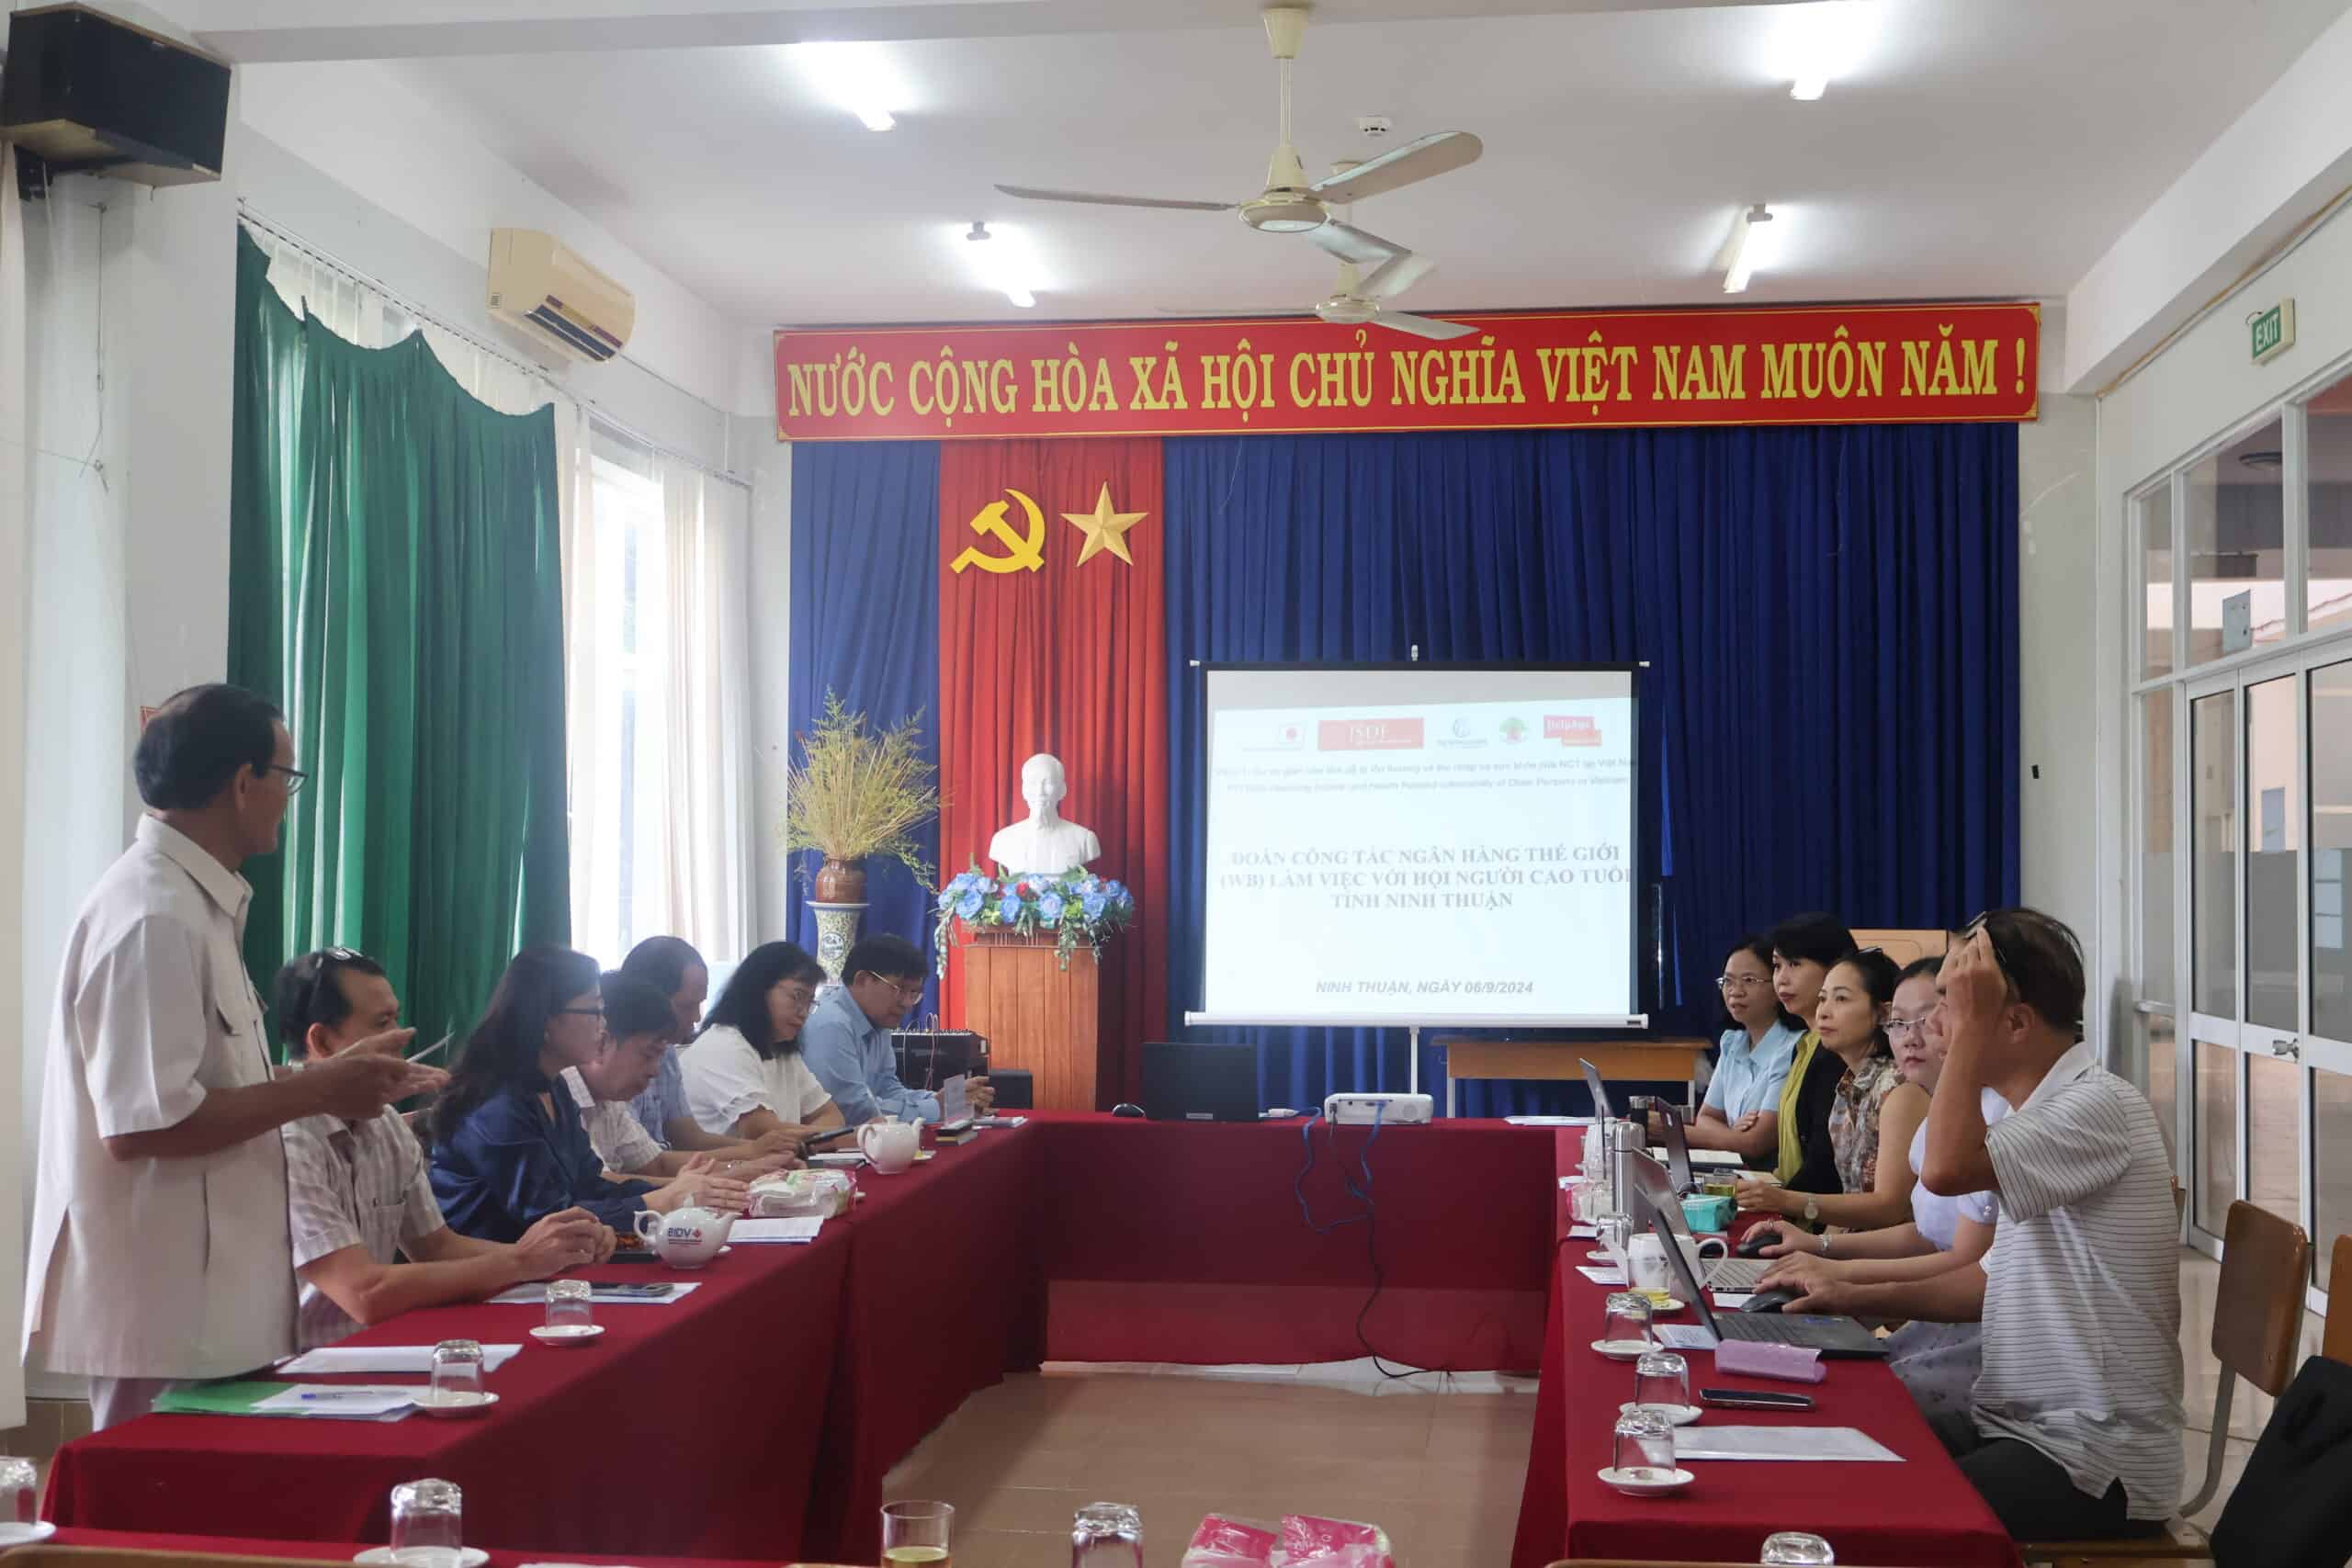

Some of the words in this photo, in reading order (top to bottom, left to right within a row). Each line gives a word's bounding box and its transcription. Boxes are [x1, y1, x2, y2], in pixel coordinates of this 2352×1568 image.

[2256, 313, 2278, 352] EXIT
[787, 345, 895, 416] NƯỚC
[909, 344, 1018, 427] CỘNG
[1031, 342, 1119, 412] HÒA
[1129, 340, 1188, 411] XÃ
[1201, 338, 1275, 423] HỘI
[1289, 329, 1374, 407] CHỦ
[1390, 334, 1526, 405] NGHĨA
[1536, 330, 1638, 415] VIỆT
[1653, 344, 1746, 400] NAM
[1760, 324, 1886, 398] MUÔN
[1900, 323, 1999, 396] NĂM
[1291, 846, 1349, 865] CÔNG
[1397, 844, 1455, 864] NGÂN
[1462, 844, 1520, 863] HÀNG
[1573, 840, 1619, 861] GIỚI
[1220, 873, 1265, 889] (WB)
[1319, 869, 1368, 889] VIỆC
[1372, 867, 1408, 887] VỚI
[1413, 866, 1450, 888] HỘI
[1530, 869, 1575, 884] CAO
[1386, 893, 1435, 908] NINH
[1441, 889, 1514, 910] THUẬN
[1316, 981, 1352, 993] NINH
[1358, 979, 1412, 995] THUẬN,
[1416, 979, 1462, 993] NGÀY
[1464, 980, 1534, 994] 06/9/2024
[668, 1227, 691, 1237] BIDV
